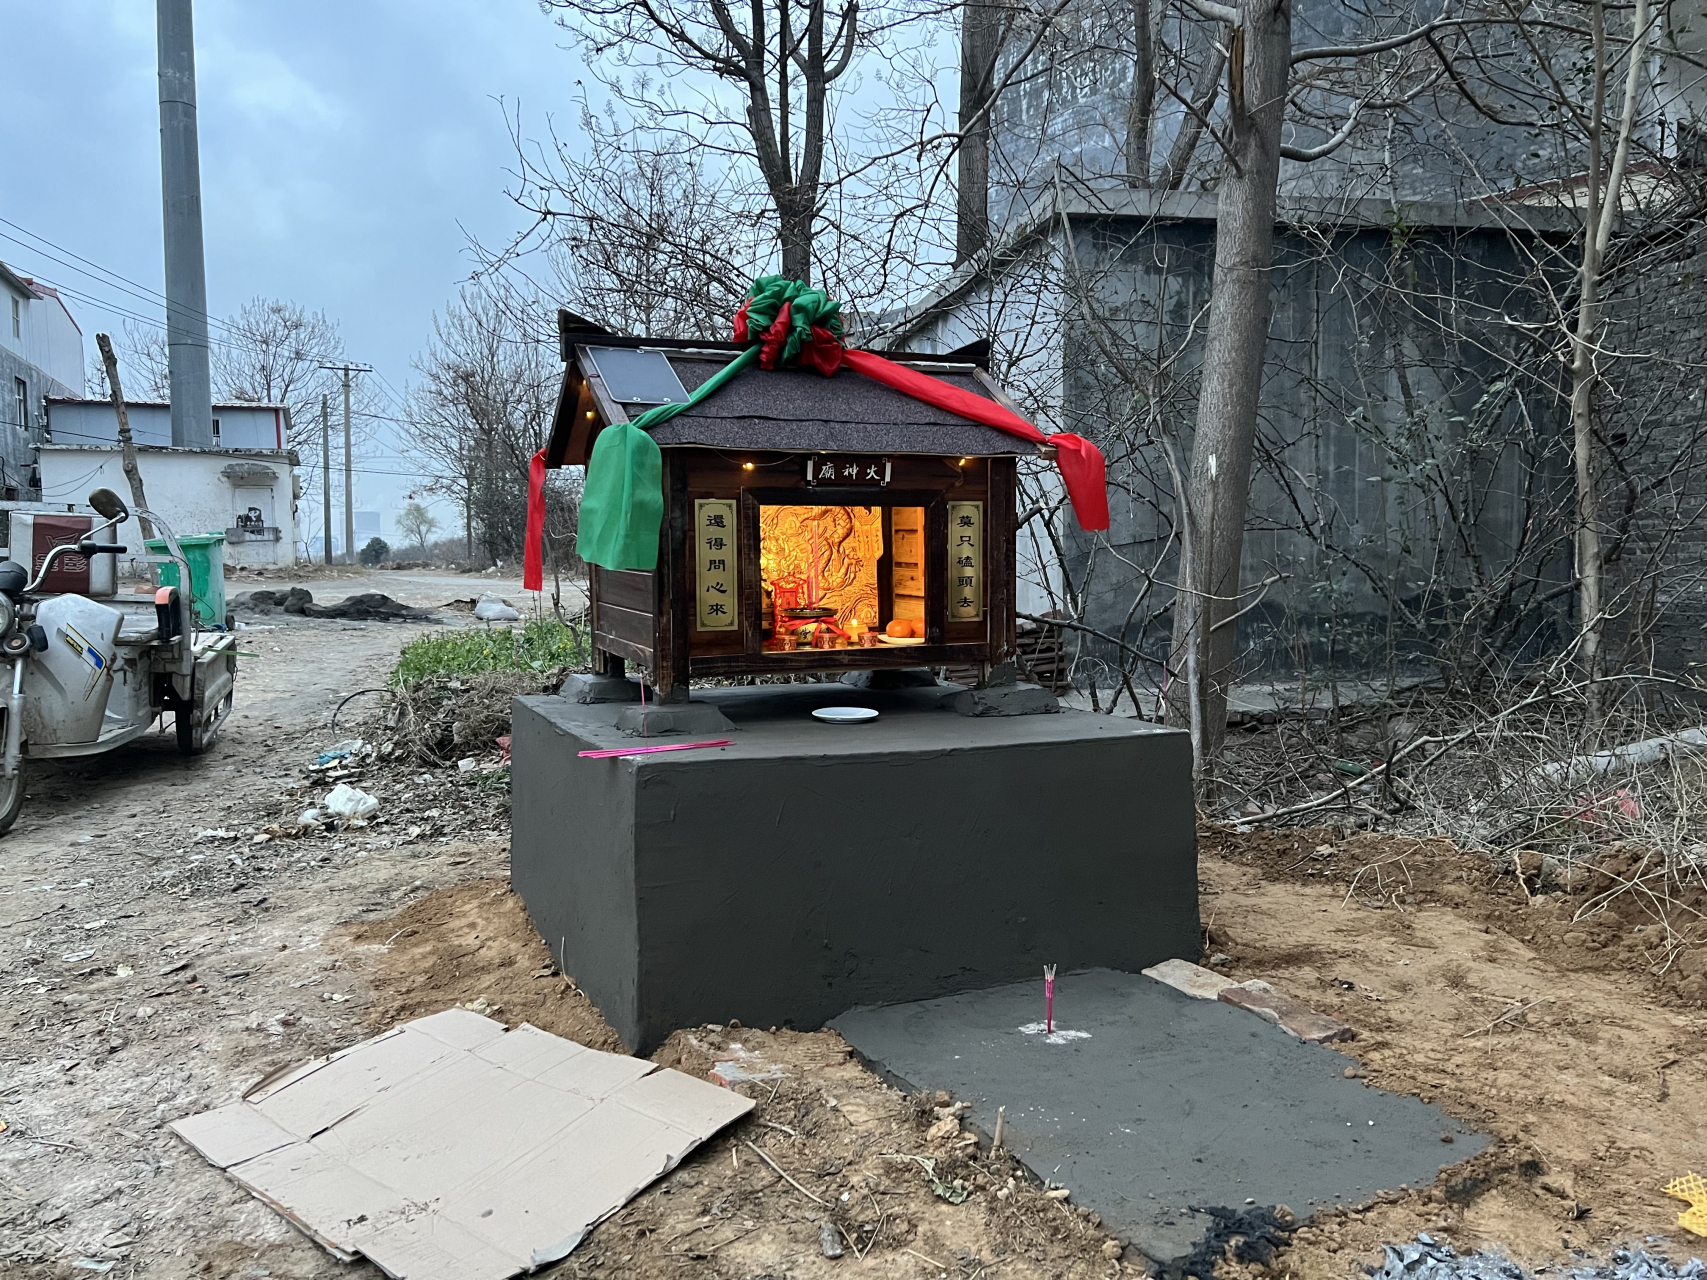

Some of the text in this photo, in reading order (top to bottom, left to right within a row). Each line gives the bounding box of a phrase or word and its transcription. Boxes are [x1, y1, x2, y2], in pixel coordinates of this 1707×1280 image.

[705, 514, 728, 616] 還得問心來
[956, 515, 975, 608] 莫只磕頭去
